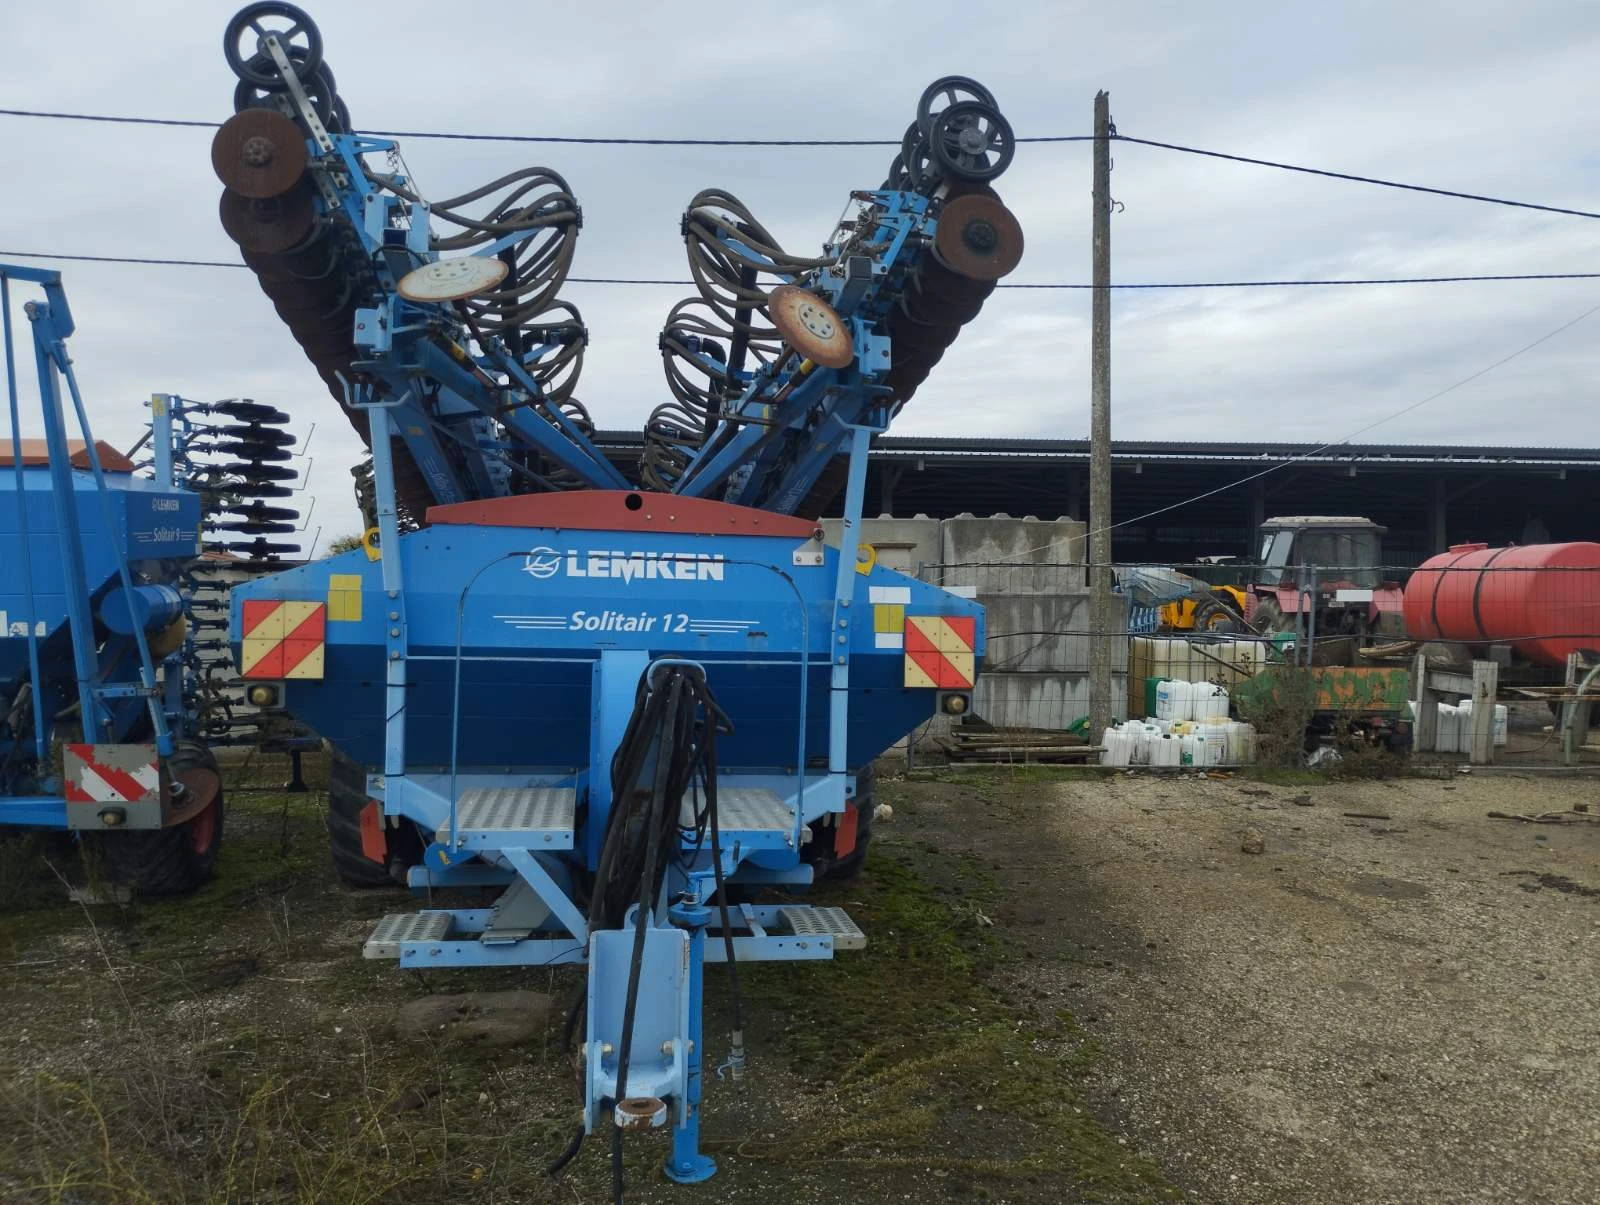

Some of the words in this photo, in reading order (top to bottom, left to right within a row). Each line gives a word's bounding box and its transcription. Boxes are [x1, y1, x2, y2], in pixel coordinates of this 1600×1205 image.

[153, 528, 175, 542] Solitair
[176, 528, 181, 542] 9
[566, 549, 724, 584] LEMKEN
[569, 610, 656, 632] Solitair
[663, 613, 689, 633] 12
